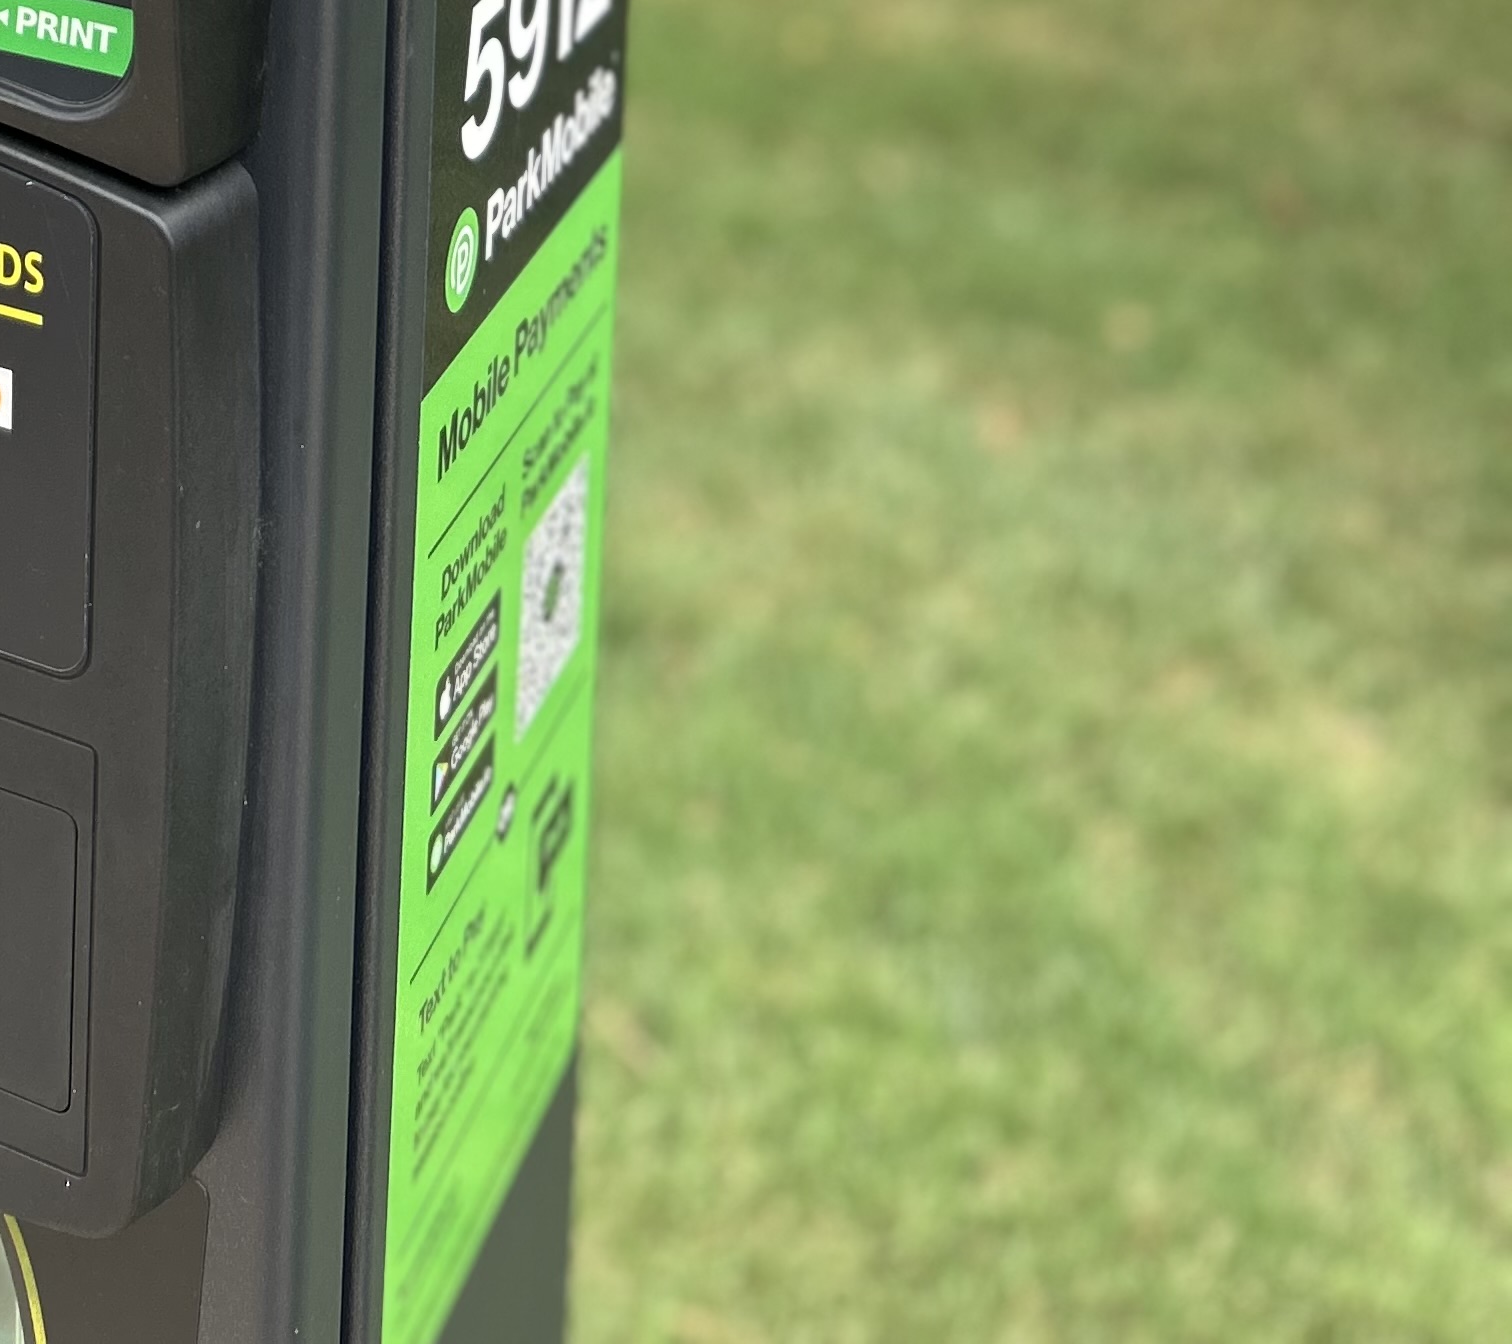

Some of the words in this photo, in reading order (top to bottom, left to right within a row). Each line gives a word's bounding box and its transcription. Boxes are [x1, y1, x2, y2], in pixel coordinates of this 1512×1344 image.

[16, 5, 118, 54] PRINT
[484, 65, 616, 261] ParkMobile
[437, 354, 510, 484] Mobile
[435, 527, 508, 652] ParkMobile
[441, 482, 506, 602] Download
[419, 967, 447, 1035] Text
